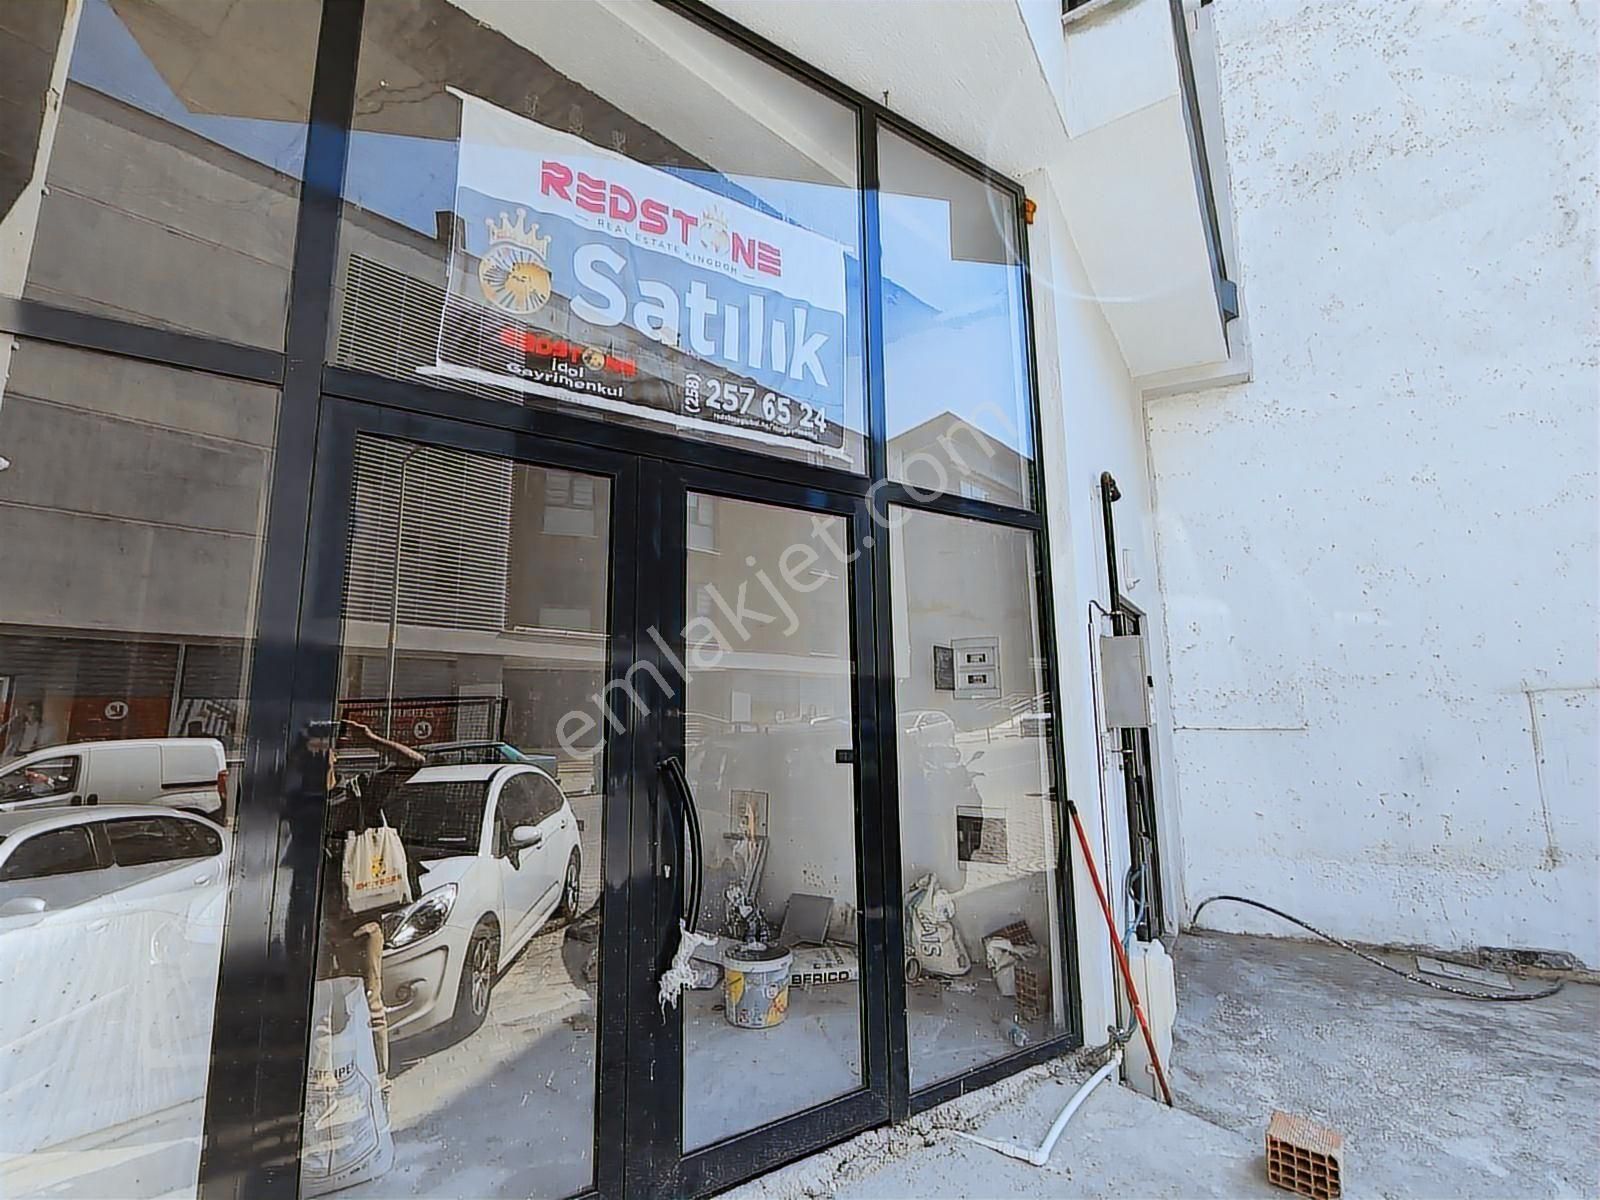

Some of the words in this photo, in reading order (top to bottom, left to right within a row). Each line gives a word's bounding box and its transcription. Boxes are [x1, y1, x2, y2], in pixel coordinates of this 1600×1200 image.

[598, 218, 630, 237] REAL
[635, 232, 680, 252] ESTATE
[685, 252, 738, 275] KINGDOM
[570, 243, 829, 387] Satılık
[506, 361, 623, 397] Gayrimenkul
[685, 373, 701, 413] (258)
[705, 379, 756, 415] 257
[762, 392, 791, 425] 65
[800, 402, 827, 434] 24
